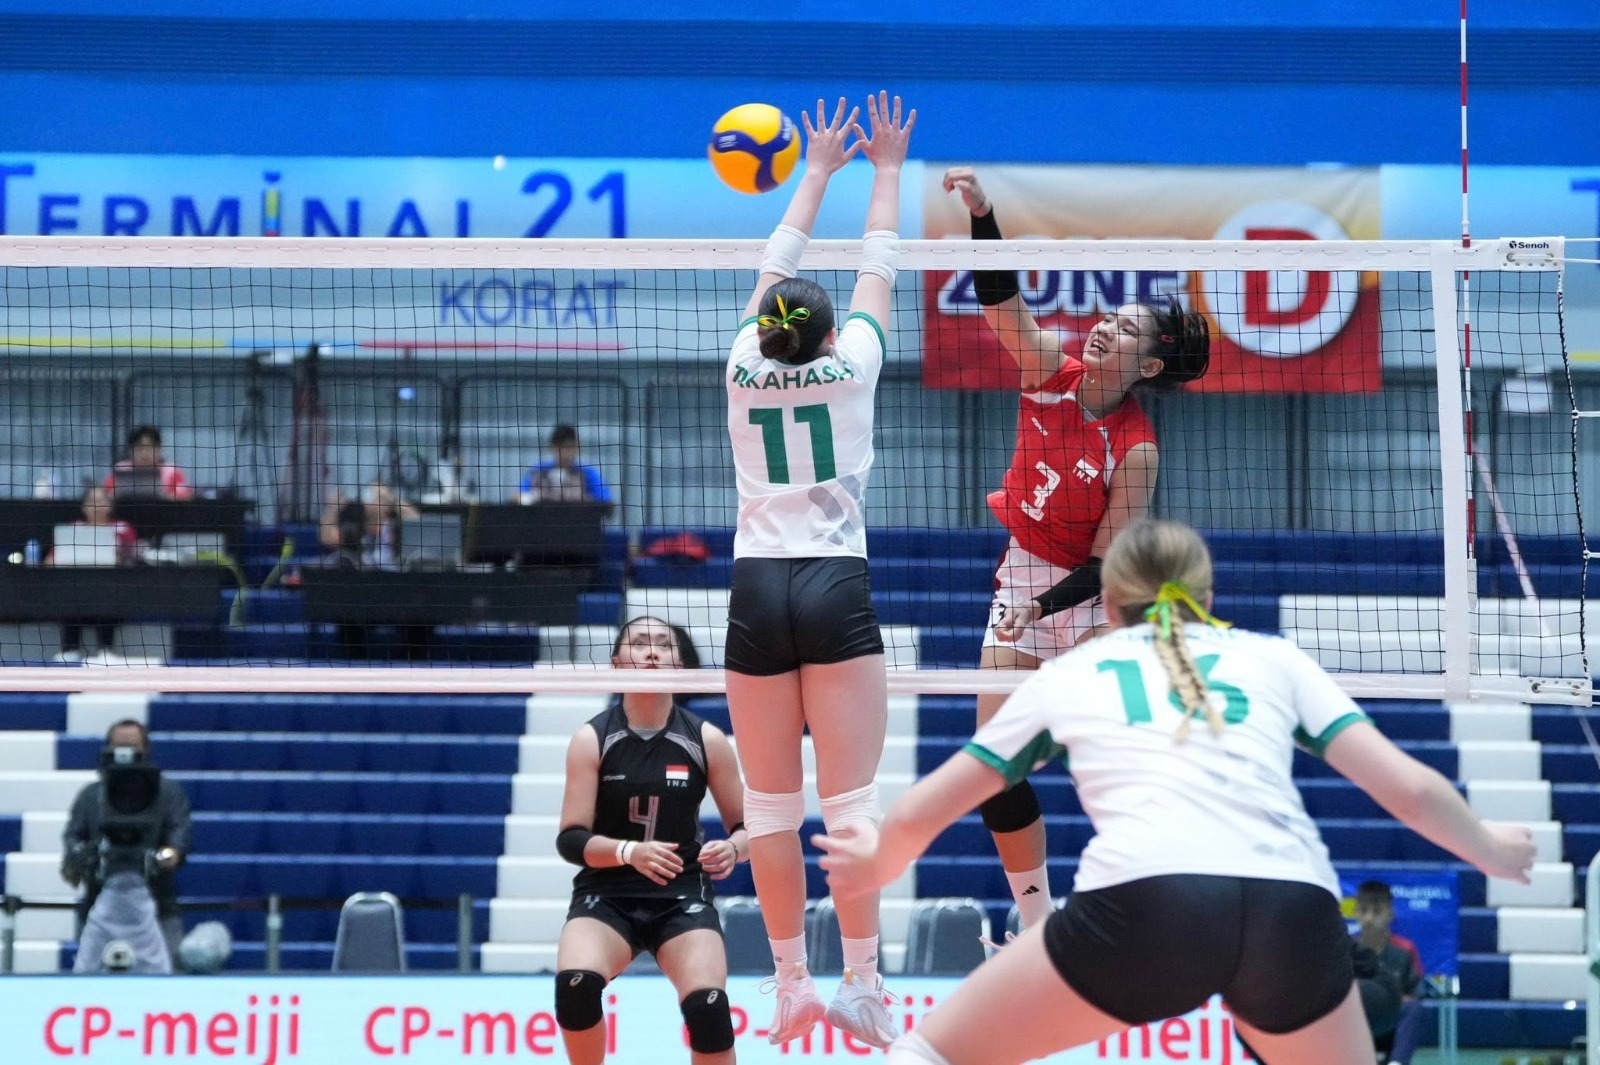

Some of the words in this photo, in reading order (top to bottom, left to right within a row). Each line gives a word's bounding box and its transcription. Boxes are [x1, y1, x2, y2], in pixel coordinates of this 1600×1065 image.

[522, 169, 628, 238] 21
[438, 278, 626, 326] KORAT
[1244, 229, 1323, 326] D
[748, 403, 837, 484] 11
[1072, 467, 1092, 485] INA
[1020, 461, 1061, 522] 3
[1096, 653, 1249, 726] 16
[666, 780, 688, 788] INA
[629, 795, 660, 842] 4
[44, 994, 300, 1065] CP-meiji
[364, 994, 617, 1056] CP-mei
